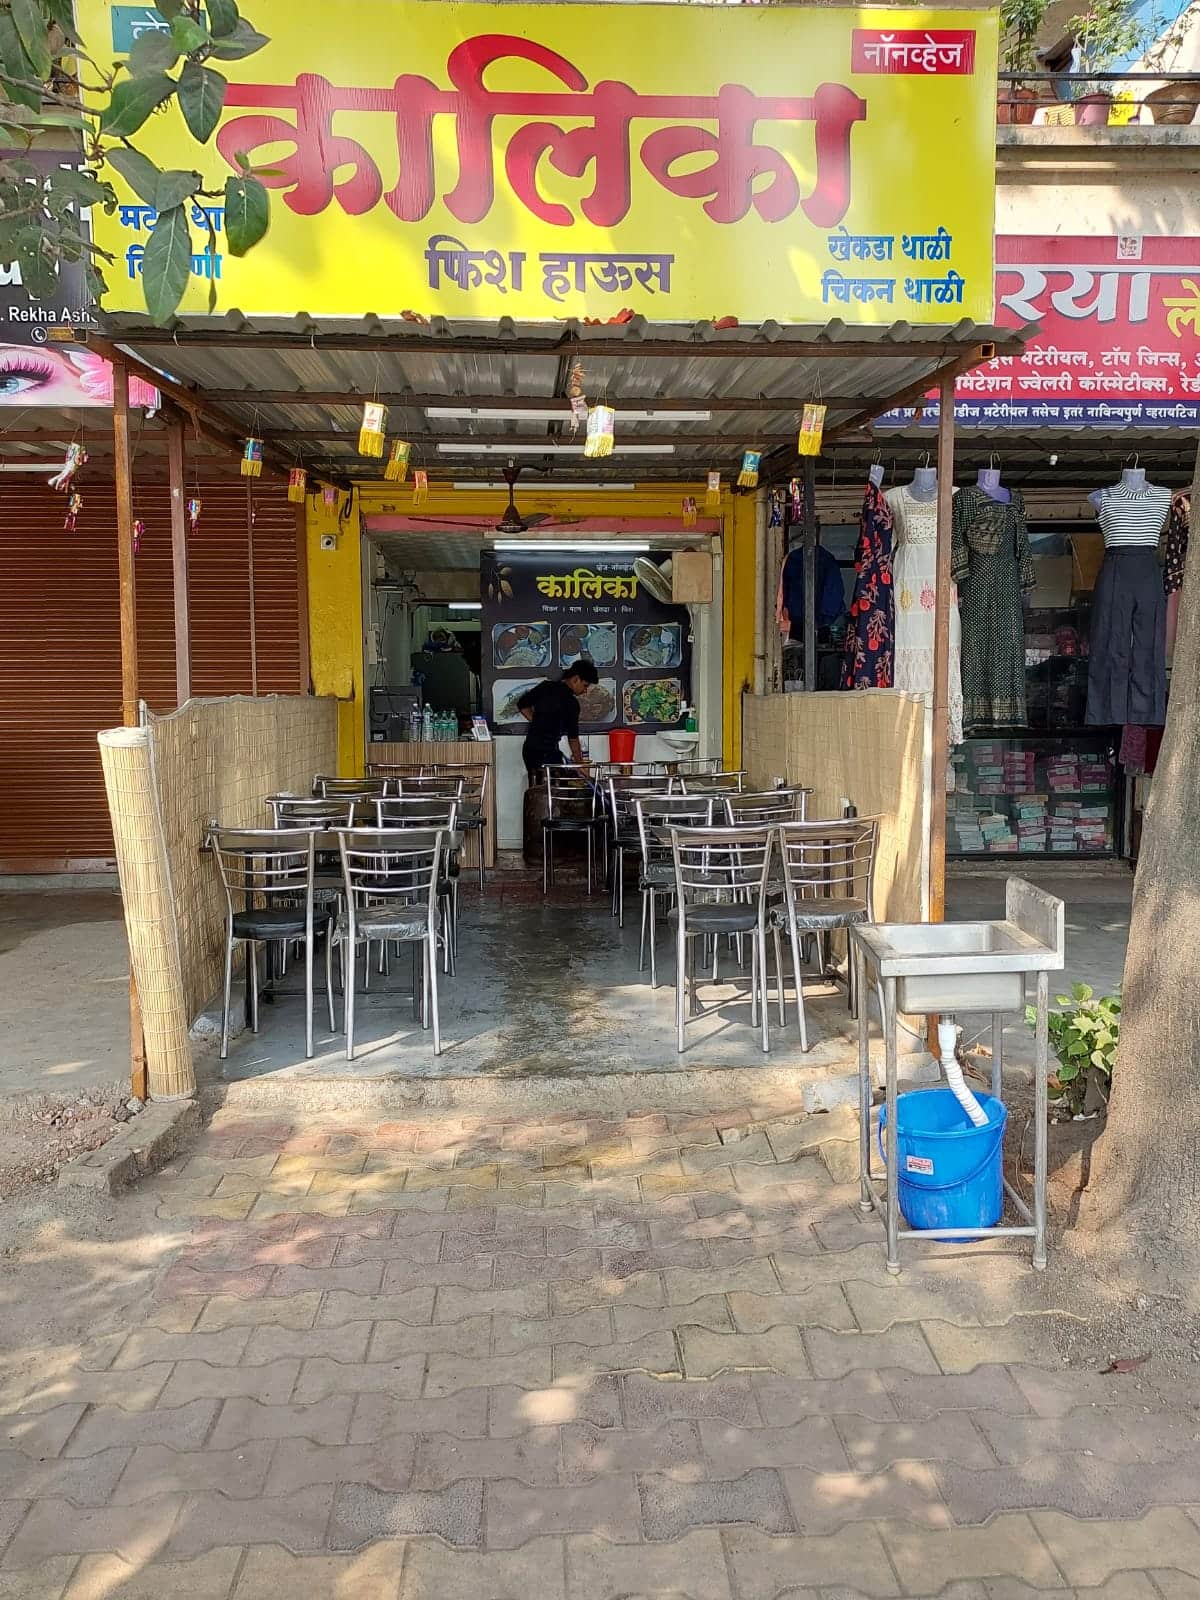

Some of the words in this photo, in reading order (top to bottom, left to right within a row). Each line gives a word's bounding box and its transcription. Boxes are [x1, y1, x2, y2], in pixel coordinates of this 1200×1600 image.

[863, 33, 964, 72] नॉनव्हेज
[216, 34, 867, 227] कालिका
[119, 206, 160, 231] मट
[191, 205, 225, 231] था
[828, 226, 895, 261] खेकडा
[901, 226, 953, 261] थाळी
[424, 234, 527, 294] फिश
[539, 252, 675, 302] हाऊस
[821, 269, 896, 303] चिकन
[904, 269, 965, 303] थाळी
[8, 306, 57, 322] Rekha
[60, 306, 98, 323] Ash
[1101, 346, 1131, 366] टॉप
[1137, 345, 1187, 369] जिन्स,
[1017, 370, 1073, 391] ज्वेलरी
[1078, 370, 1174, 394] कॉस्मेटीक्स,
[983, 403, 1028, 418] मटेरीयल
[1032, 402, 1060, 418] तसेच
[1063, 406, 1083, 420] इतर
[536, 568, 638, 599] कालिका
